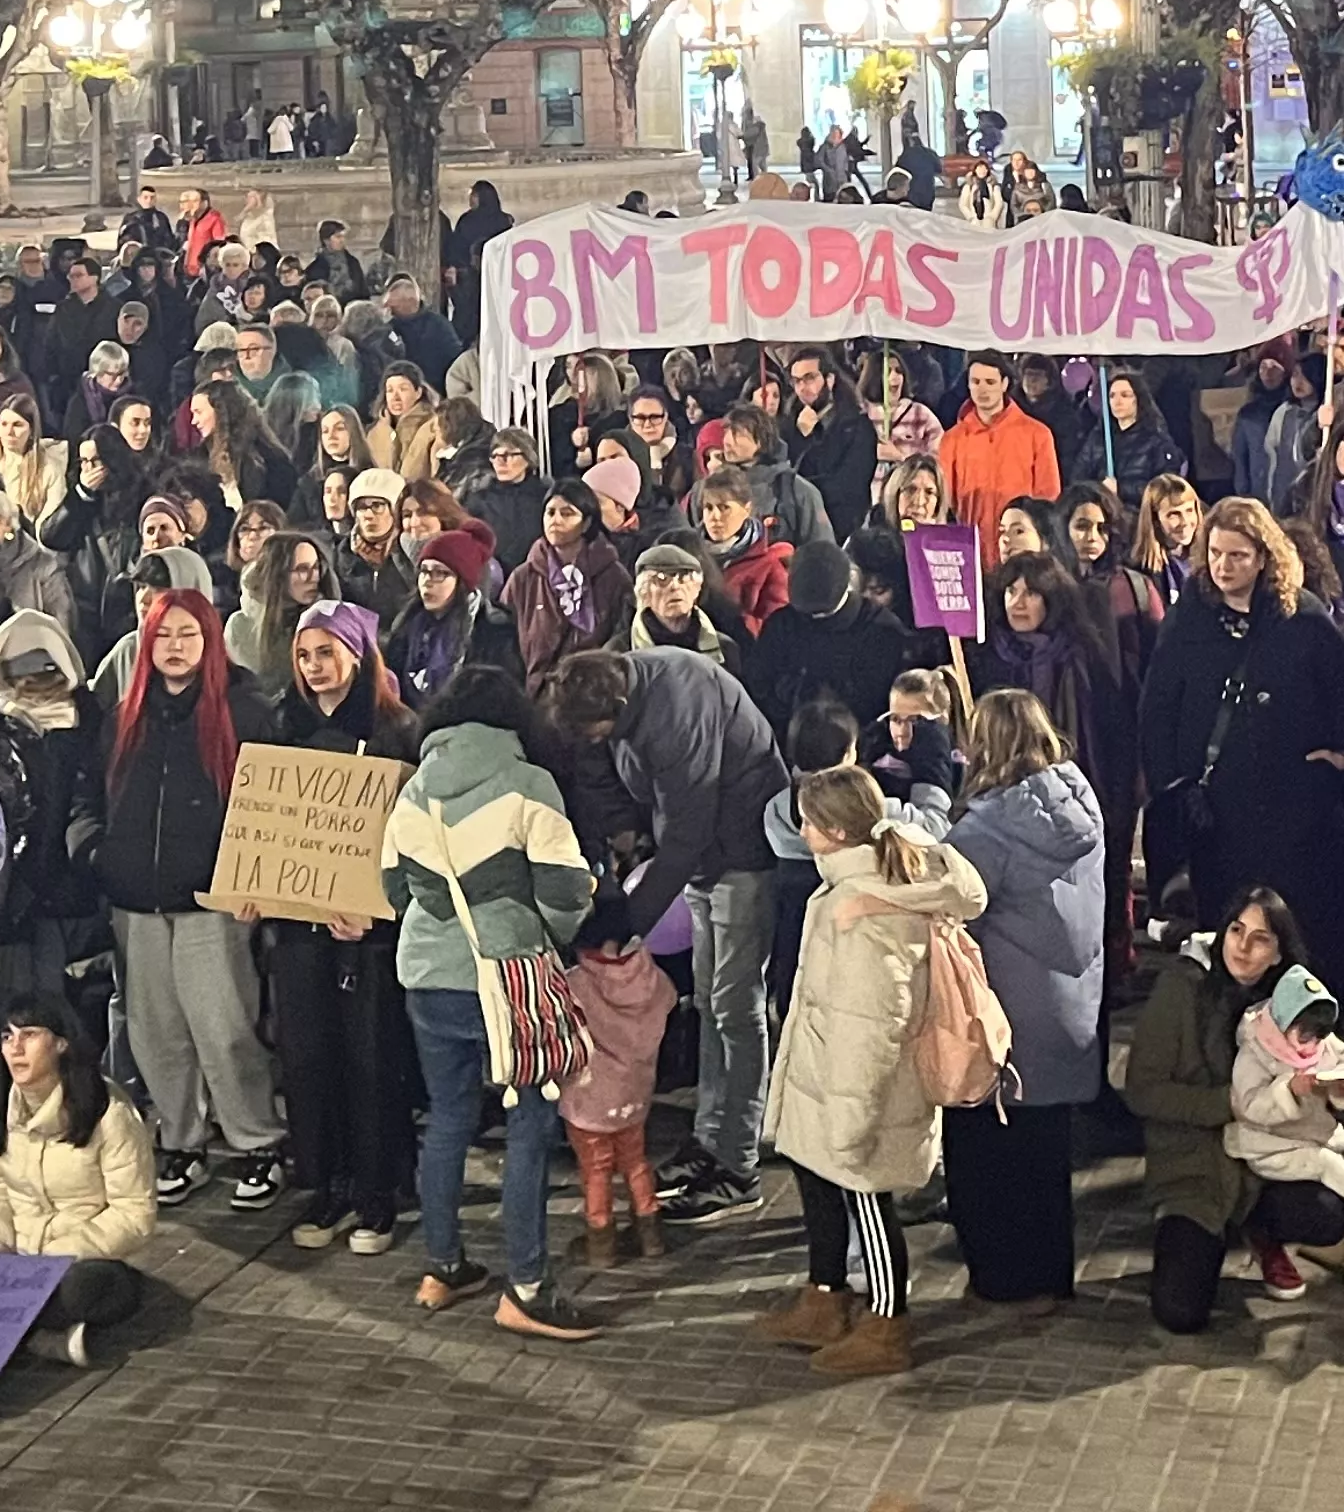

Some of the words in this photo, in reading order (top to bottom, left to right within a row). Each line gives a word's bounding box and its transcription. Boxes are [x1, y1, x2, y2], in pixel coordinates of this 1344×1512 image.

[510, 229, 658, 350] 8M
[682, 221, 960, 329] TODAS
[989, 235, 1217, 342] UNIDAS
[296, 764, 396, 815] VIOLAN
[306, 806, 366, 834] PORRO
[276, 857, 339, 903] POLI
